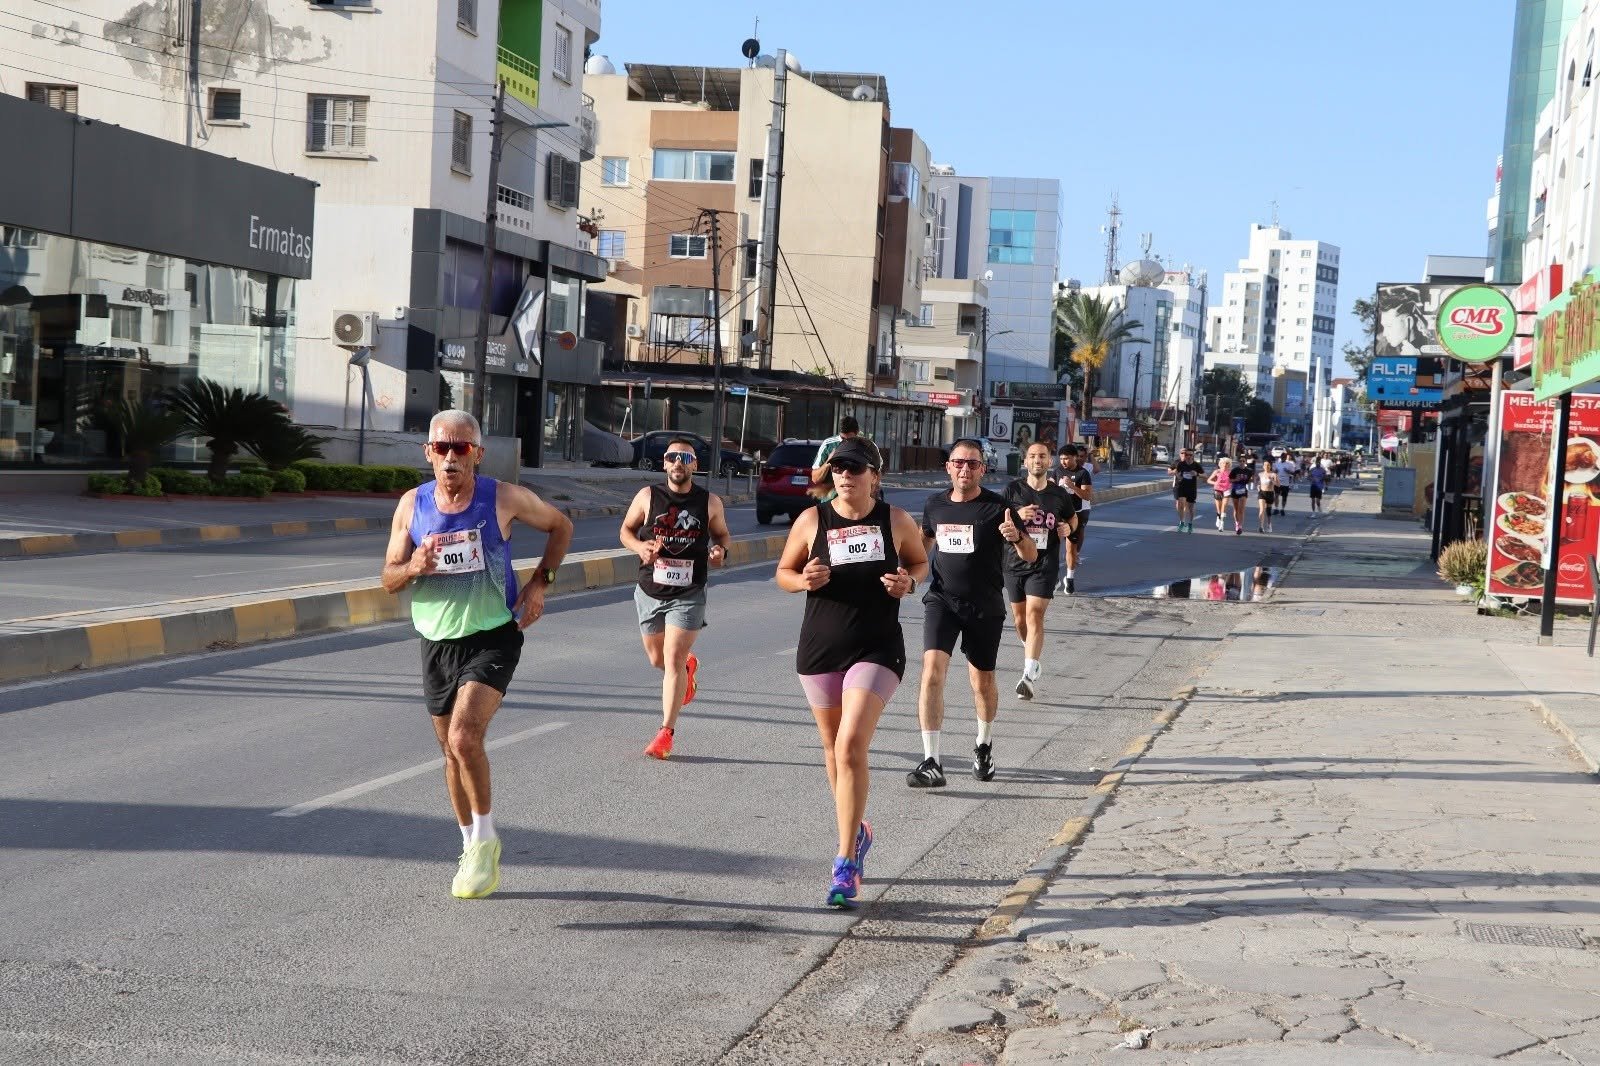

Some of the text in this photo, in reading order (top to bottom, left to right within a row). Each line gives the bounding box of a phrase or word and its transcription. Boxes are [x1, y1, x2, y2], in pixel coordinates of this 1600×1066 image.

[249, 214, 311, 263] Ermataş
[1450, 308, 1504, 335] CMR
[1509, 396, 1558, 408] MEHME
[948, 537, 962, 546] 150
[848, 543, 867, 554] 002
[444, 552, 464, 564] 001
[666, 572, 680, 580] 073
